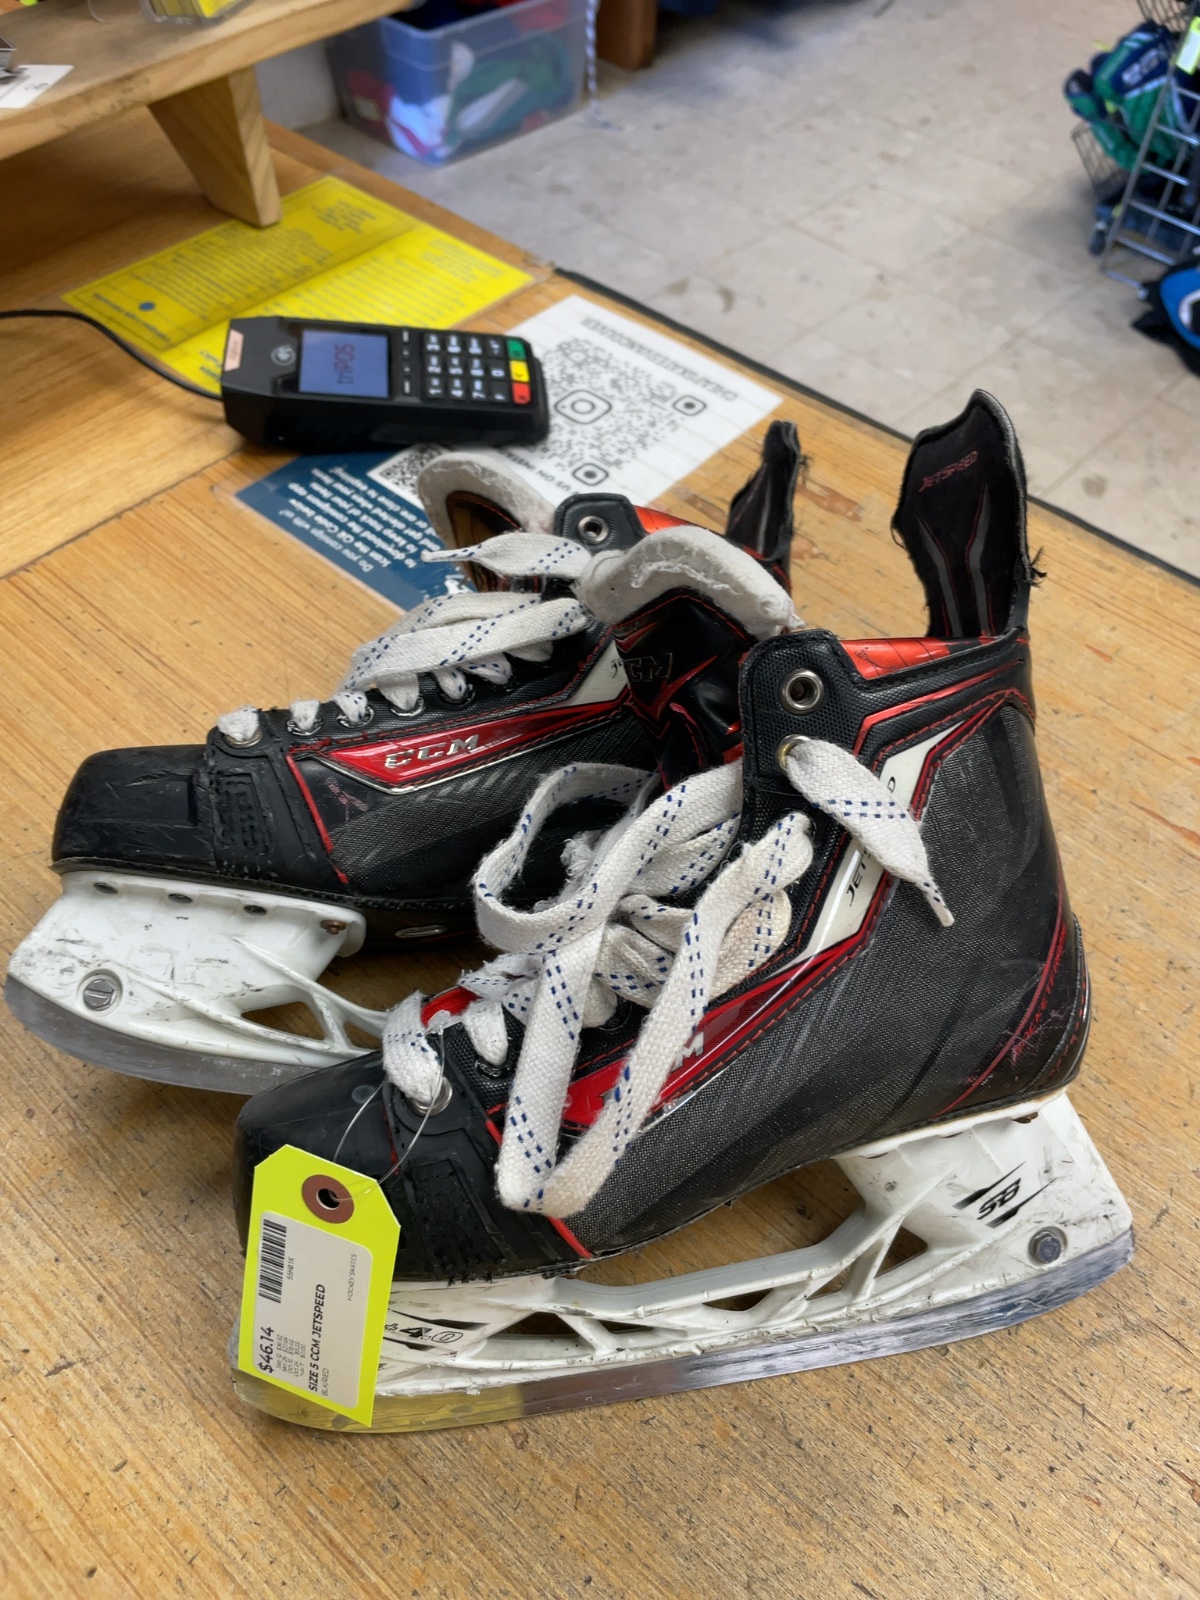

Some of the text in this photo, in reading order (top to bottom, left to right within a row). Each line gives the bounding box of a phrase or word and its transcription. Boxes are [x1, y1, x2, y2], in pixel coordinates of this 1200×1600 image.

[505, 452, 536, 472] INSTA
[917, 450, 979, 493] JETSPEED
[287, 482, 308, 496] app
[332, 482, 355, 496] your
[366, 489, 378, 499] to
[330, 496, 354, 509] your
[351, 493, 374, 510] when
[314, 515, 339, 533] Code
[359, 514, 384, 531] track
[370, 507, 406, 530] alerted
[415, 520, 428, 529] or
[347, 521, 364, 534] the
[403, 528, 423, 539] get
[310, 528, 343, 551] consign
[336, 530, 354, 543] QR
[359, 530, 406, 560] download
[382, 528, 407, 547] keep
[418, 538, 441, 551] and
[342, 548, 362, 562] you
[354, 541, 371, 554] the
[406, 543, 418, 553] to
[358, 560, 374, 572] Do
[369, 551, 392, 567] Scan
[404, 558, 417, 568] to
[629, 652, 673, 683] CM
[384, 734, 480, 769] CCM
[845, 776, 896, 908] JETD
[347, 1254, 357, 1301] HOCKEY SKATES
[309, 1284, 325, 1392] SIZE 5 CCM JETSPEED
[258, 1327, 274, 1373] $46.14
[321, 1367, 329, 1396] BLK/RED
